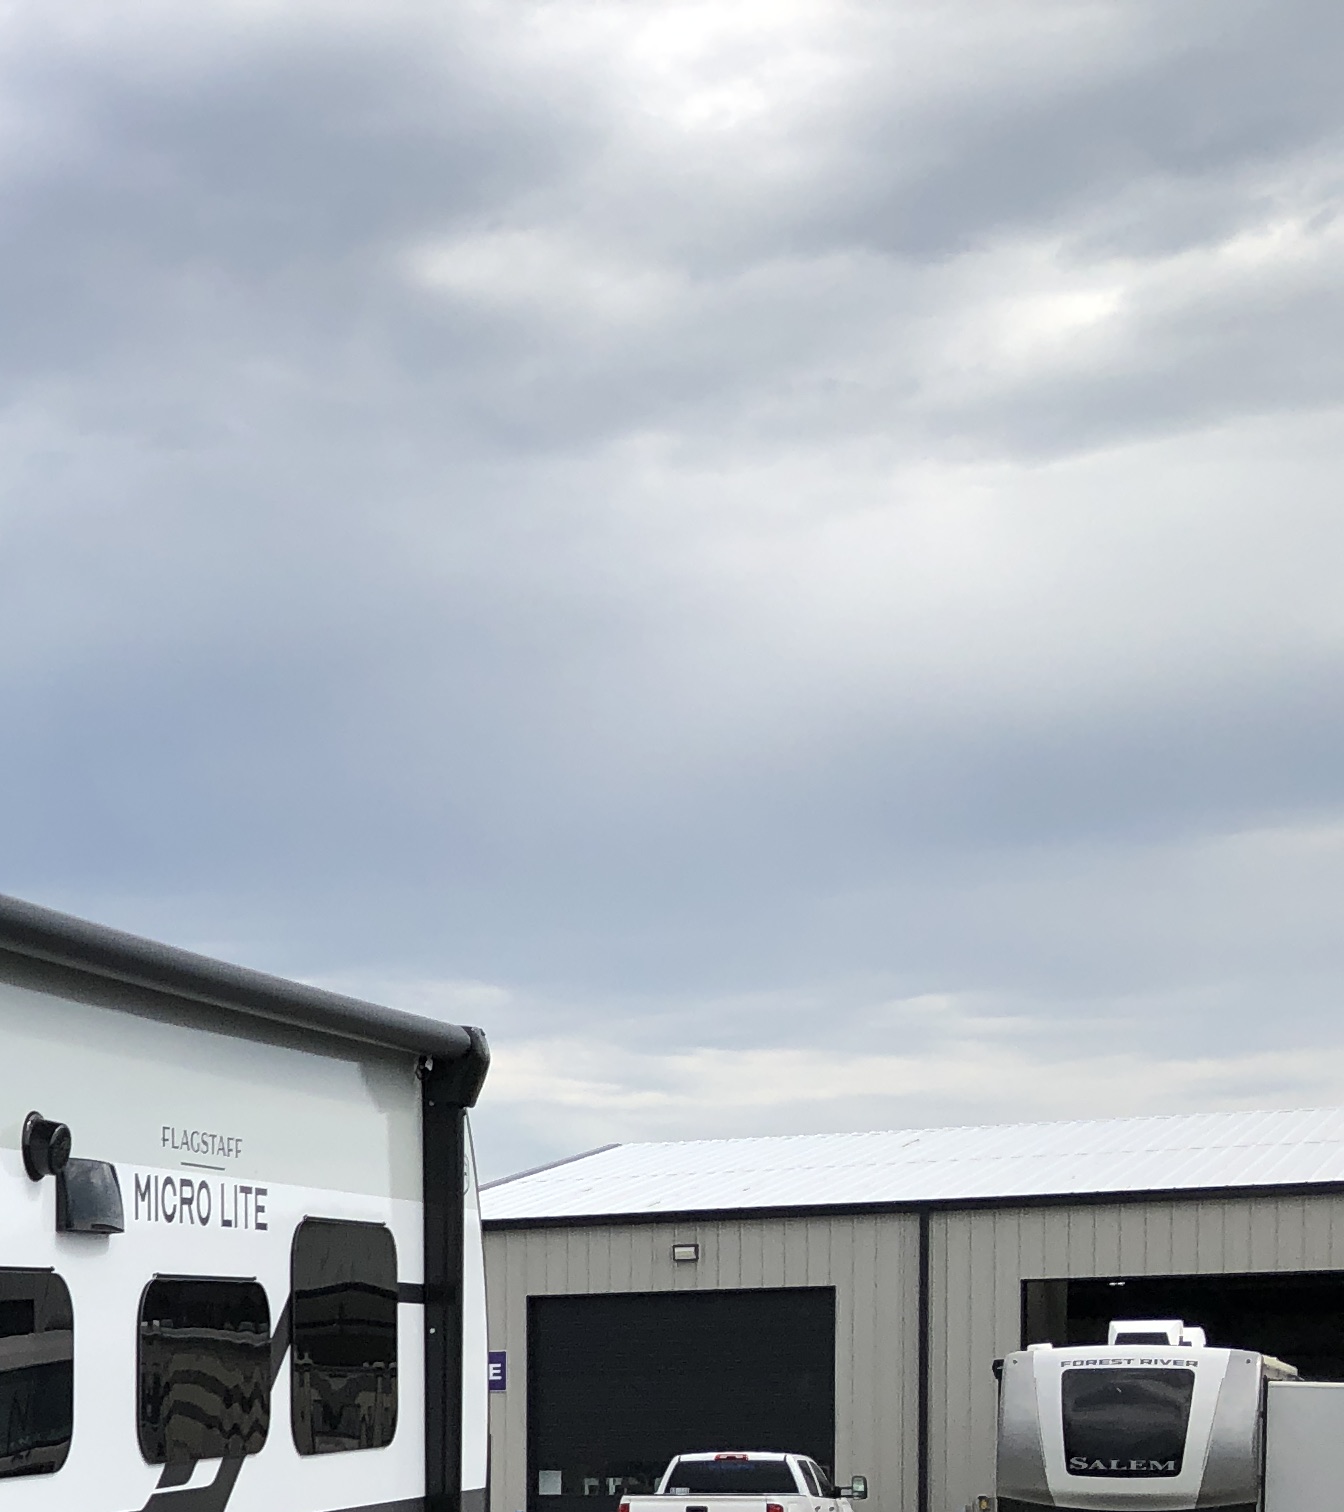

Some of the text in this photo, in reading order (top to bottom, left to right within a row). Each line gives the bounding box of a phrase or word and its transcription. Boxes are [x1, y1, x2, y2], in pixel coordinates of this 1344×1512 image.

[161, 1126, 243, 1159] FLAGSTAFF
[134, 1172, 268, 1231] MICRO LITE
[1060, 1358, 1199, 1368] FOREST RIVER
[1069, 1456, 1177, 1471] SALEM
